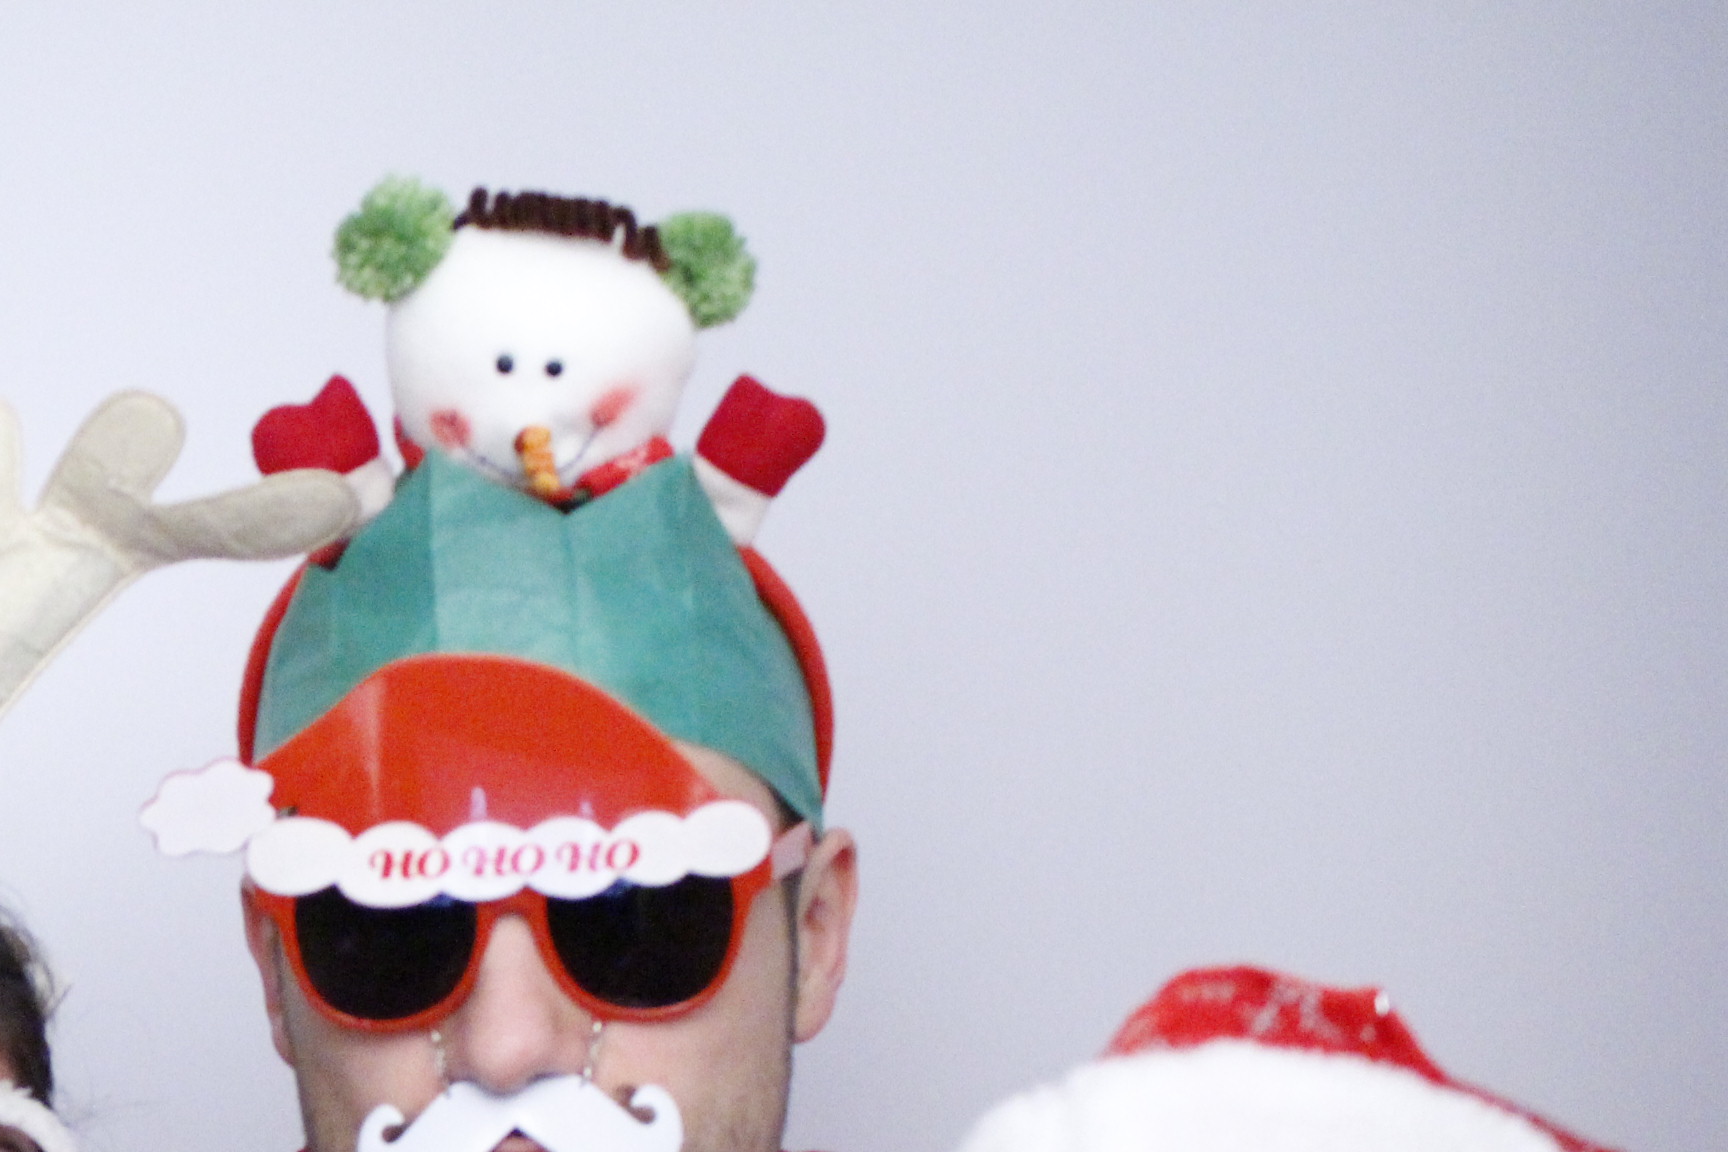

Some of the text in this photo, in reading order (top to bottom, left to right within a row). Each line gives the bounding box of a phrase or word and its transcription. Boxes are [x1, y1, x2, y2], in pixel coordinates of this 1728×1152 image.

[370, 838, 640, 879] HO HO HO
